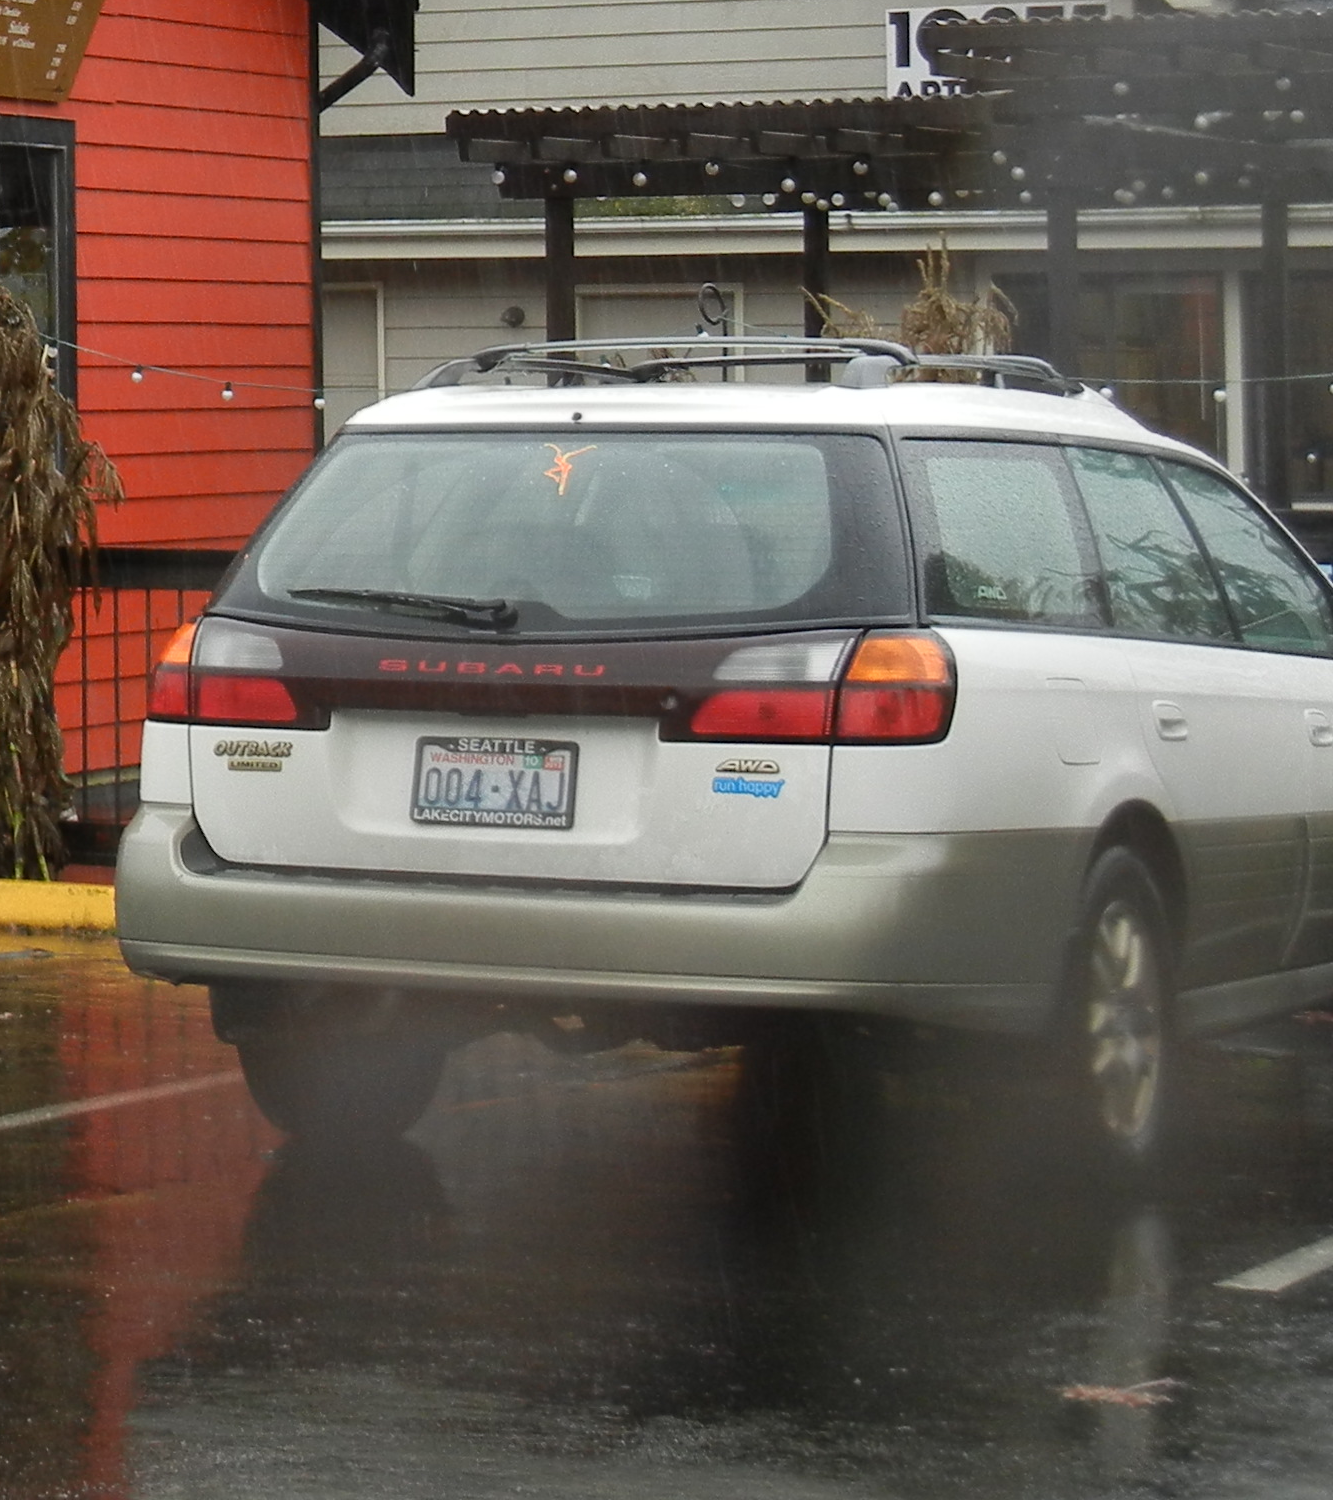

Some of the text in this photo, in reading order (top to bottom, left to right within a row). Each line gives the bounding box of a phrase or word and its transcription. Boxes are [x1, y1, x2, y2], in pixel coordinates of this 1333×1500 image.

[378, 658, 607, 677] SUBARU
[214, 740, 293, 757] OUTBACK
[457, 737, 536, 754] SEATTLE
[430, 752, 515, 766] WASHINGTON
[715, 759, 780, 774] AWD
[714, 779, 783, 796] run happy
[413, 807, 567, 827] LAKECITYMOTORS.net
